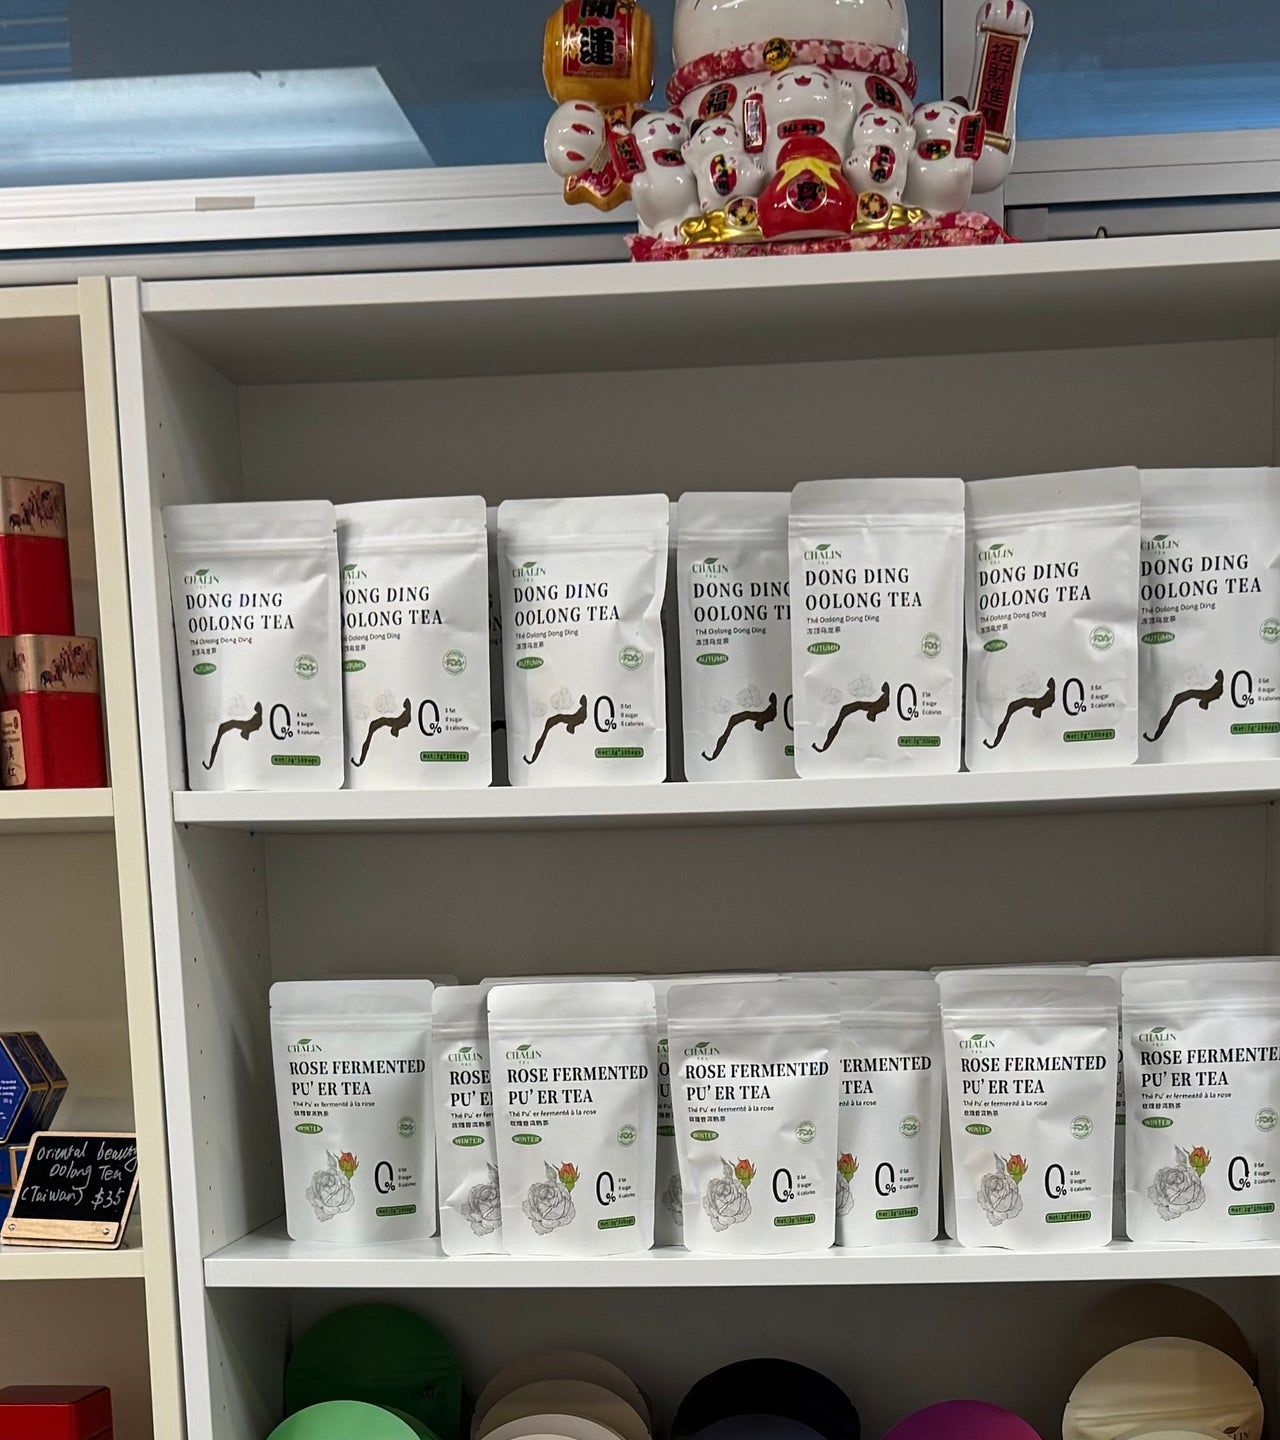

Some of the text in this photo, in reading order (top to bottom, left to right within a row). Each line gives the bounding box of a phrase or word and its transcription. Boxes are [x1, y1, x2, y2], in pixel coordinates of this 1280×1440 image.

[705, 89, 730, 115] 福
[804, 550, 842, 560] CHALIN
[1141, 554, 1248, 576] DONG DING
[806, 568, 908, 586] DONG DING
[1141, 577, 1261, 601] OOLONG TEA
[806, 592, 922, 610] OOLONG TEA
[845, 615, 863, 623] Dong
[809, 644, 838, 652] AUTUMN
[418, 699, 442, 736] 0%
[507, 1065, 648, 1083] ROSE FERMENTED
[562, 1089, 593, 1103] TEA
[49, 1160, 121, 1190] Oolong Tea
[21, 1186, 125, 1210] (Taiwan) $35
